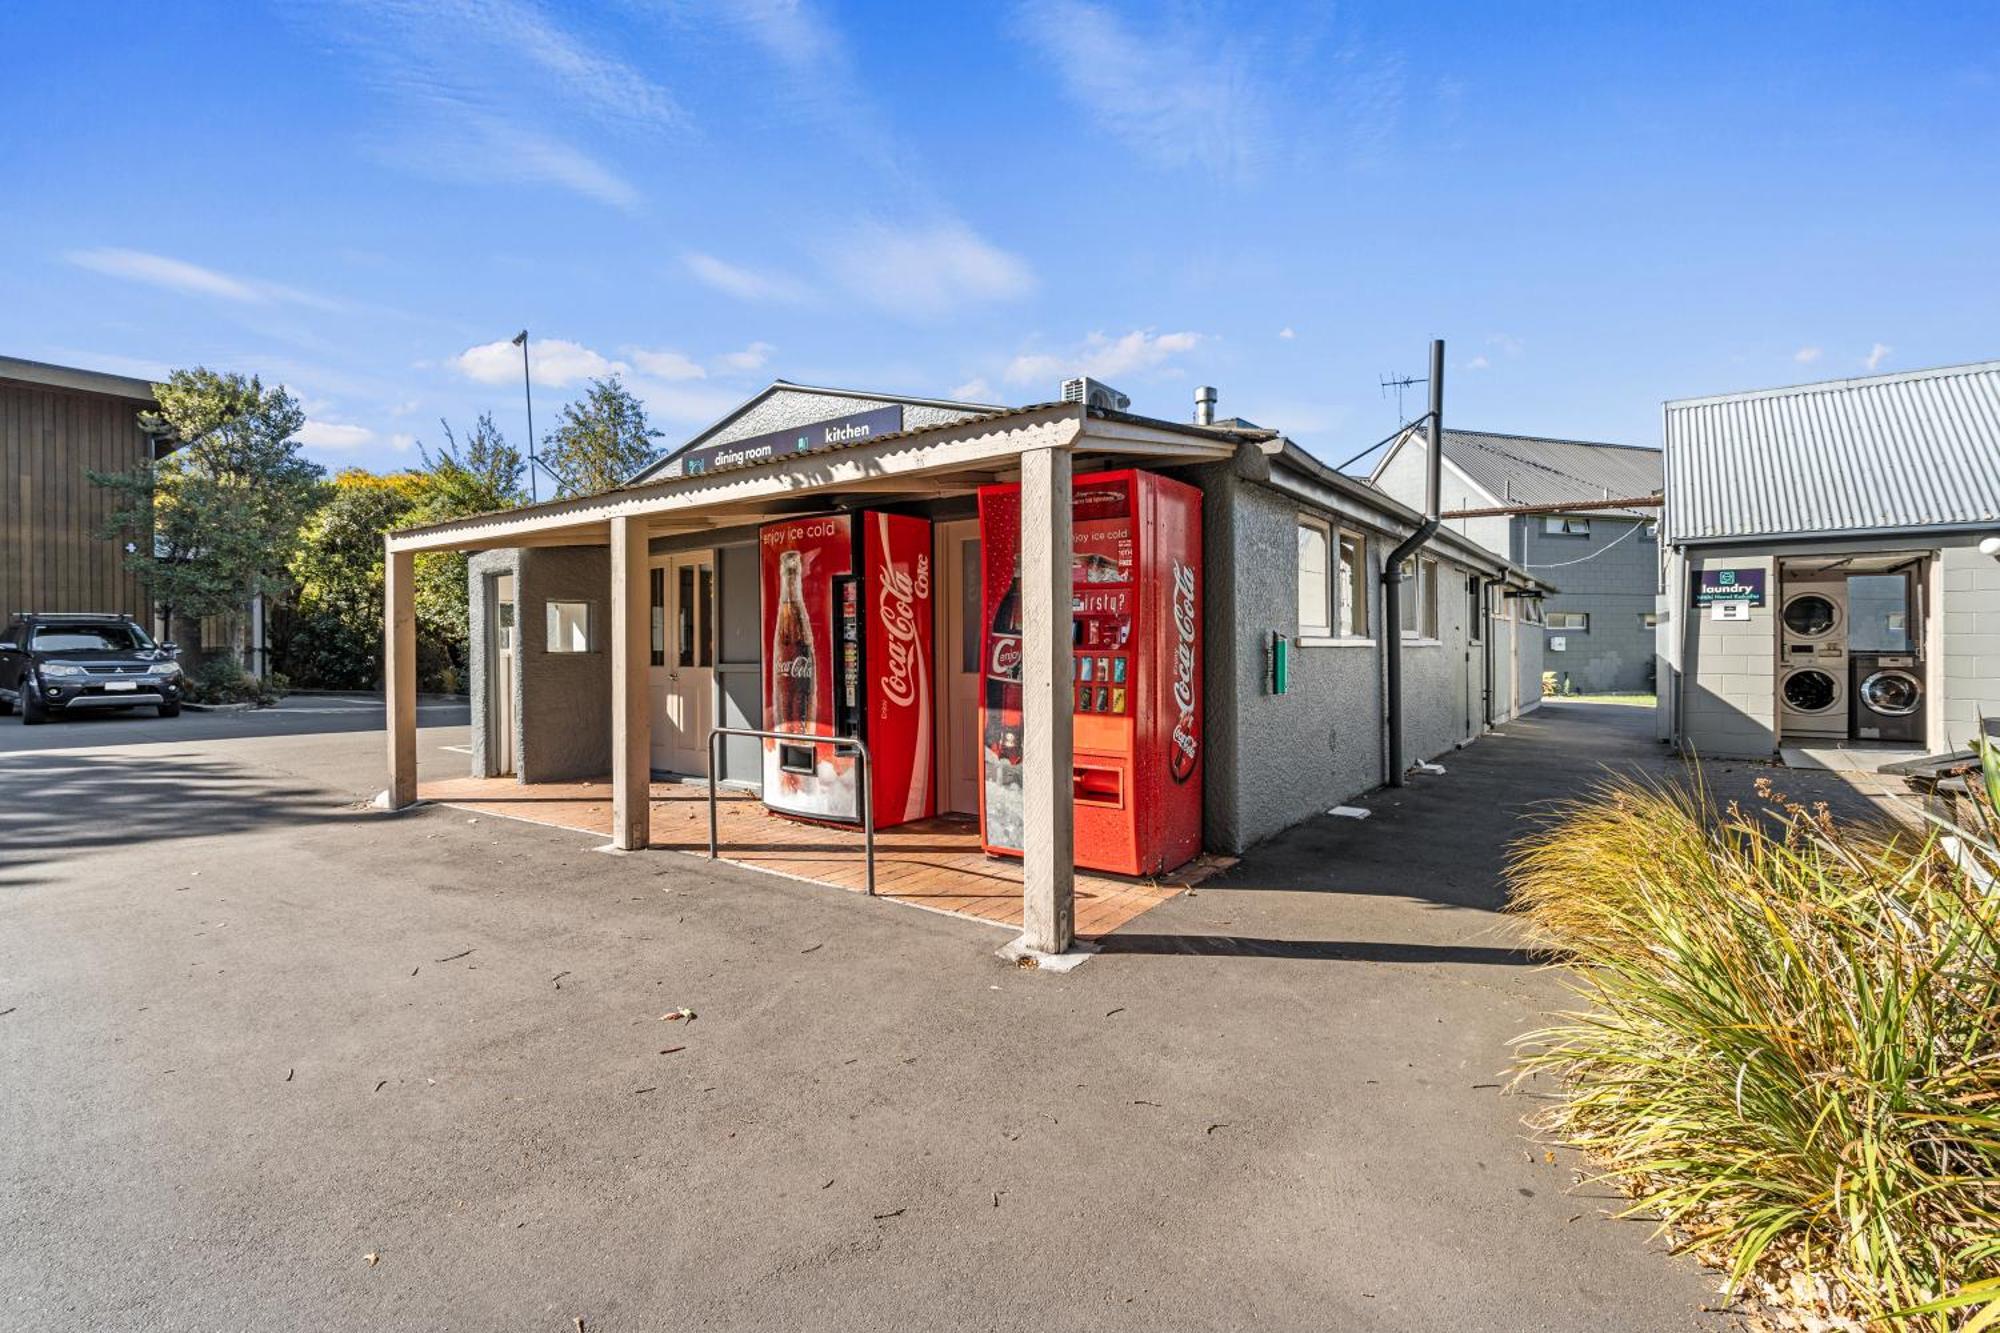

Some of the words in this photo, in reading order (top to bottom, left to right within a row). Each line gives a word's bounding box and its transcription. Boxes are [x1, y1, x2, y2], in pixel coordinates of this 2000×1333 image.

[825, 424, 870, 443] kitchen
[715, 451, 744, 465] dining
[745, 445, 772, 459] room
[763, 529, 785, 546] enjoy
[787, 526, 804, 540] ice
[807, 520, 834, 538] cold
[1091, 531, 1105, 541] ice
[1107, 529, 1128, 540] cold
[915, 554, 929, 599] Coke
[1702, 583, 1754, 595] laundry
[880, 565, 915, 707] Coca-Cola
